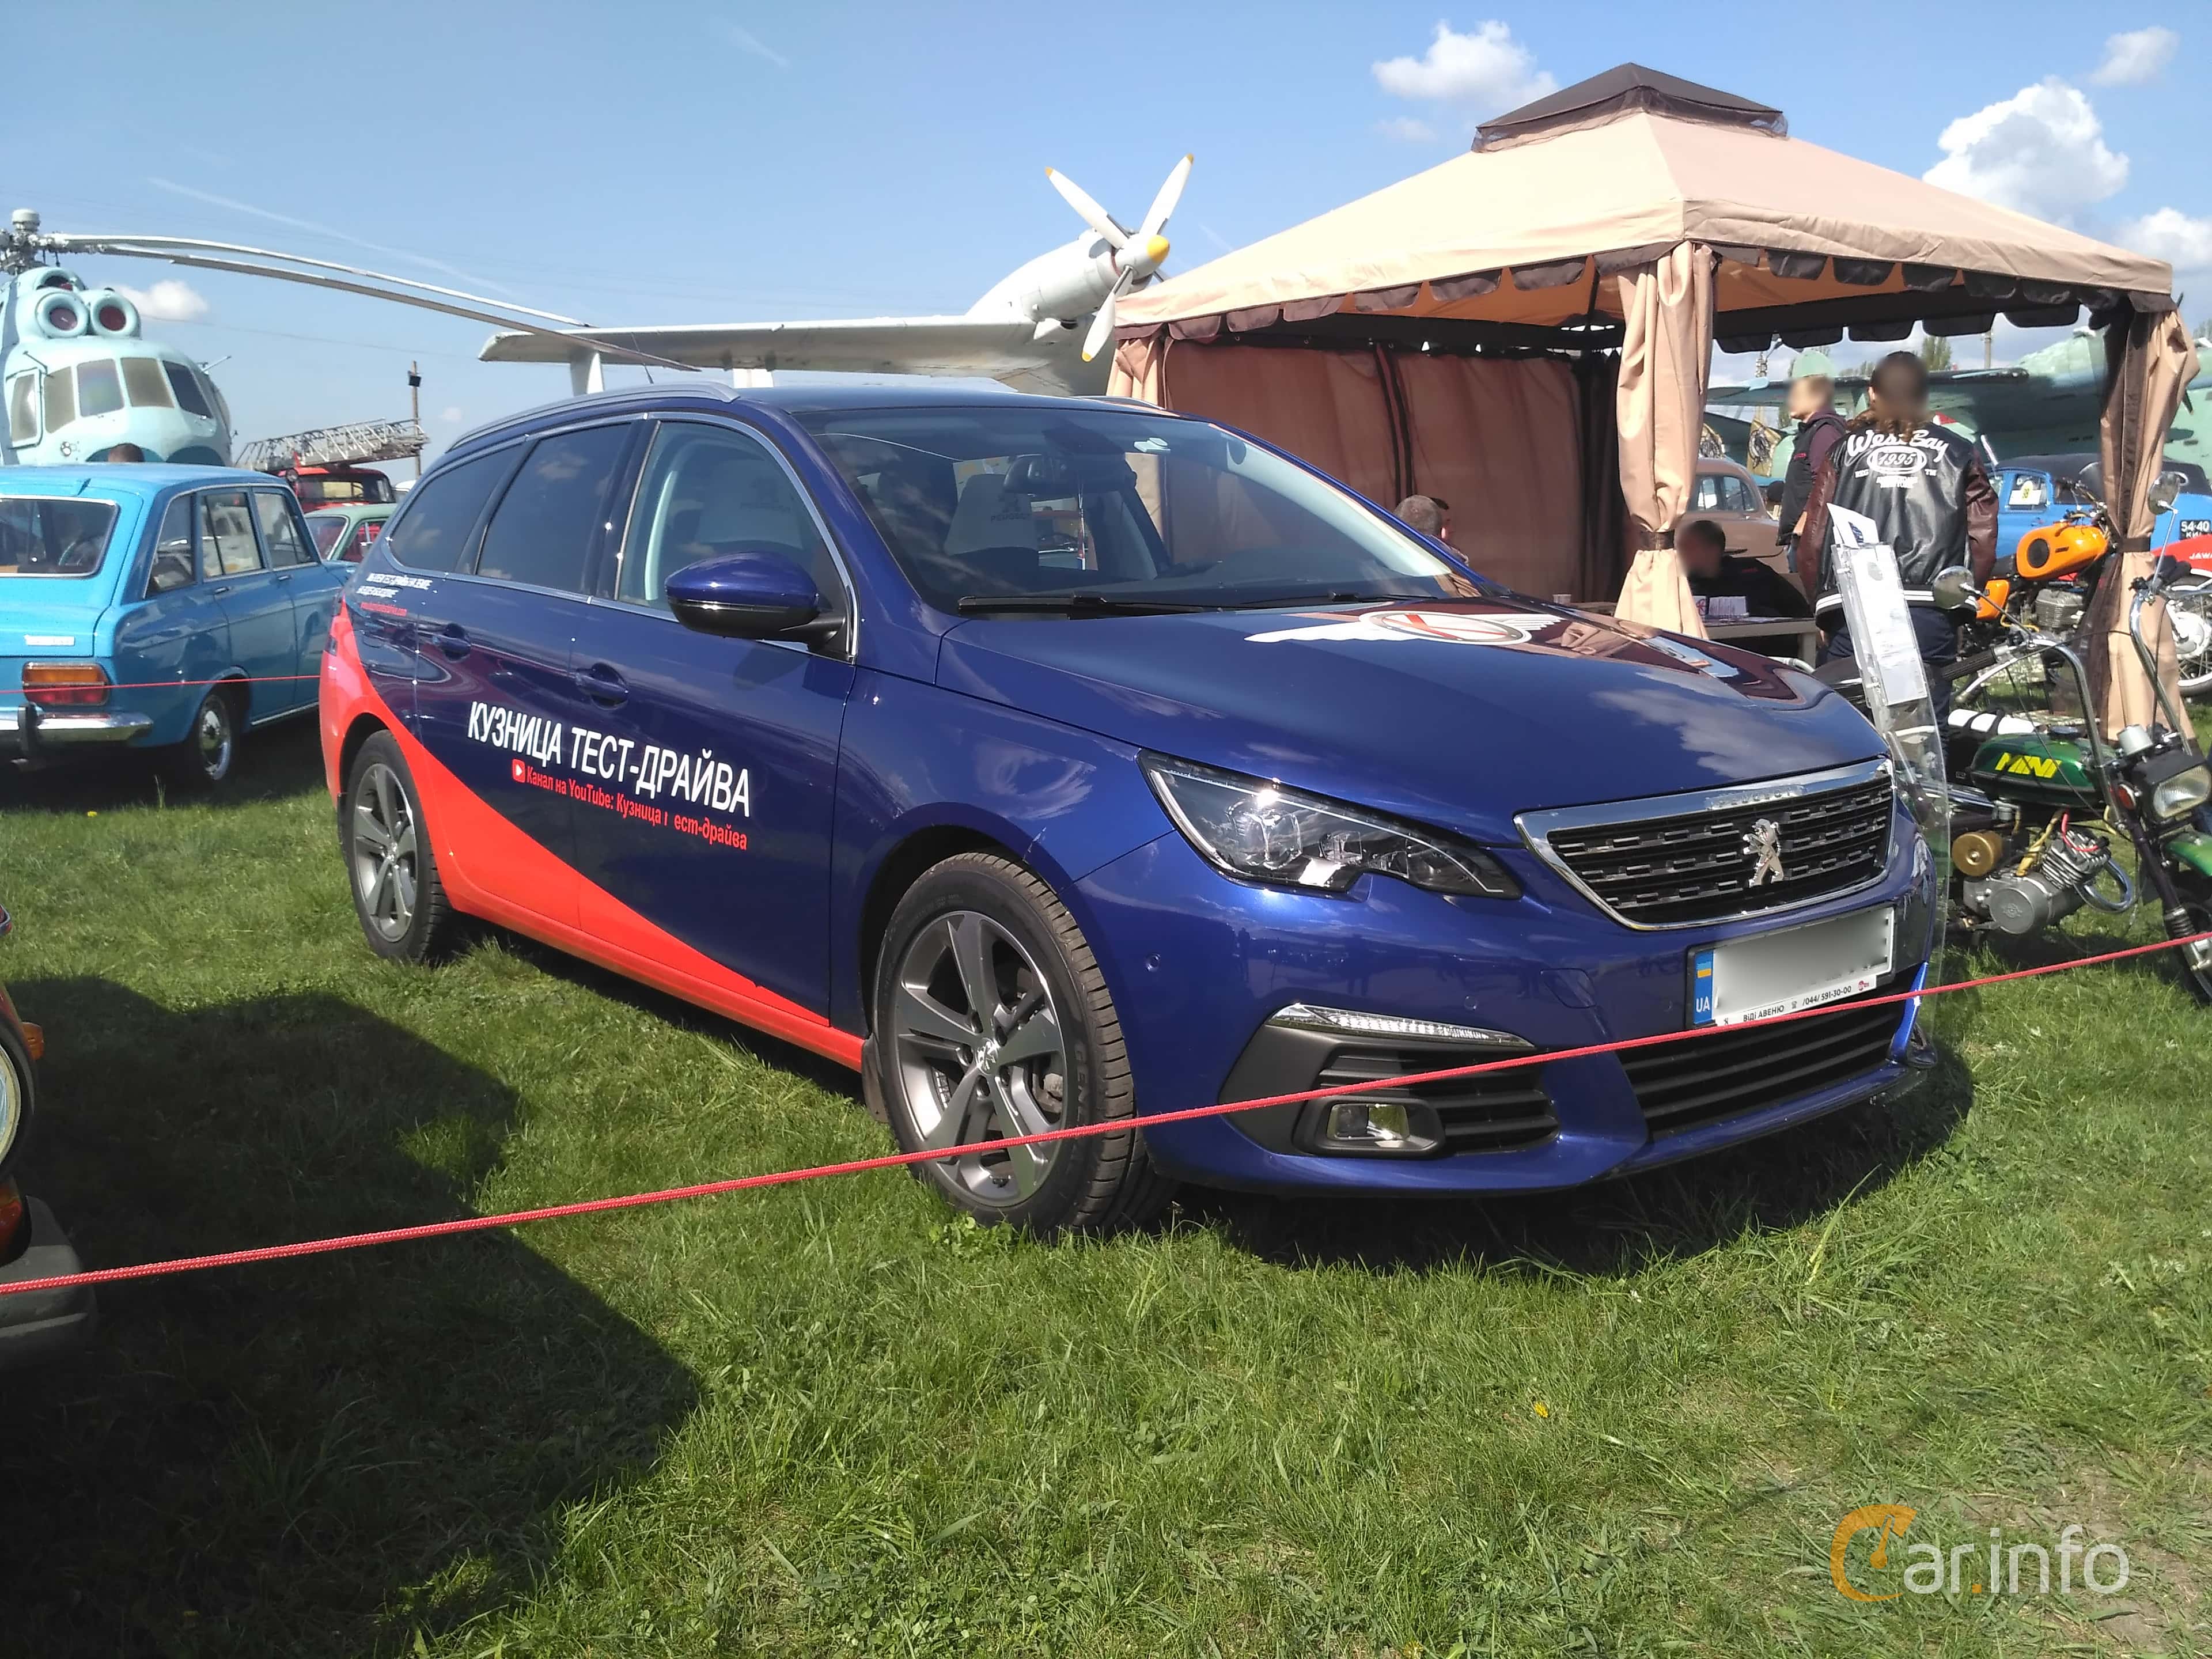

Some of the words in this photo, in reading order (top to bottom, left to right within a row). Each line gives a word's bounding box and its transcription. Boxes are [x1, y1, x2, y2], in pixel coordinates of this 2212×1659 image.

[1878, 453, 1916, 466] 1995
[1909, 430, 1949, 463] Bay
[468, 701, 562, 767] КУЗНИЦА
[571, 727, 750, 817] ТЕСТ-ДРАЙВА
[1995, 752, 2062, 779] MINI
[527, 765, 554, 790] Канал
[555, 779, 567, 794] на
[569, 778, 614, 810] YouTube:
[616, 793, 661, 827] Кузница
[1696, 997, 1710, 1013] UA
[1758, 1005, 1785, 1018] АВЕНЮ
[1802, 994, 1820, 1007] /044/
[1821, 985, 1852, 1001] 591-30-00
